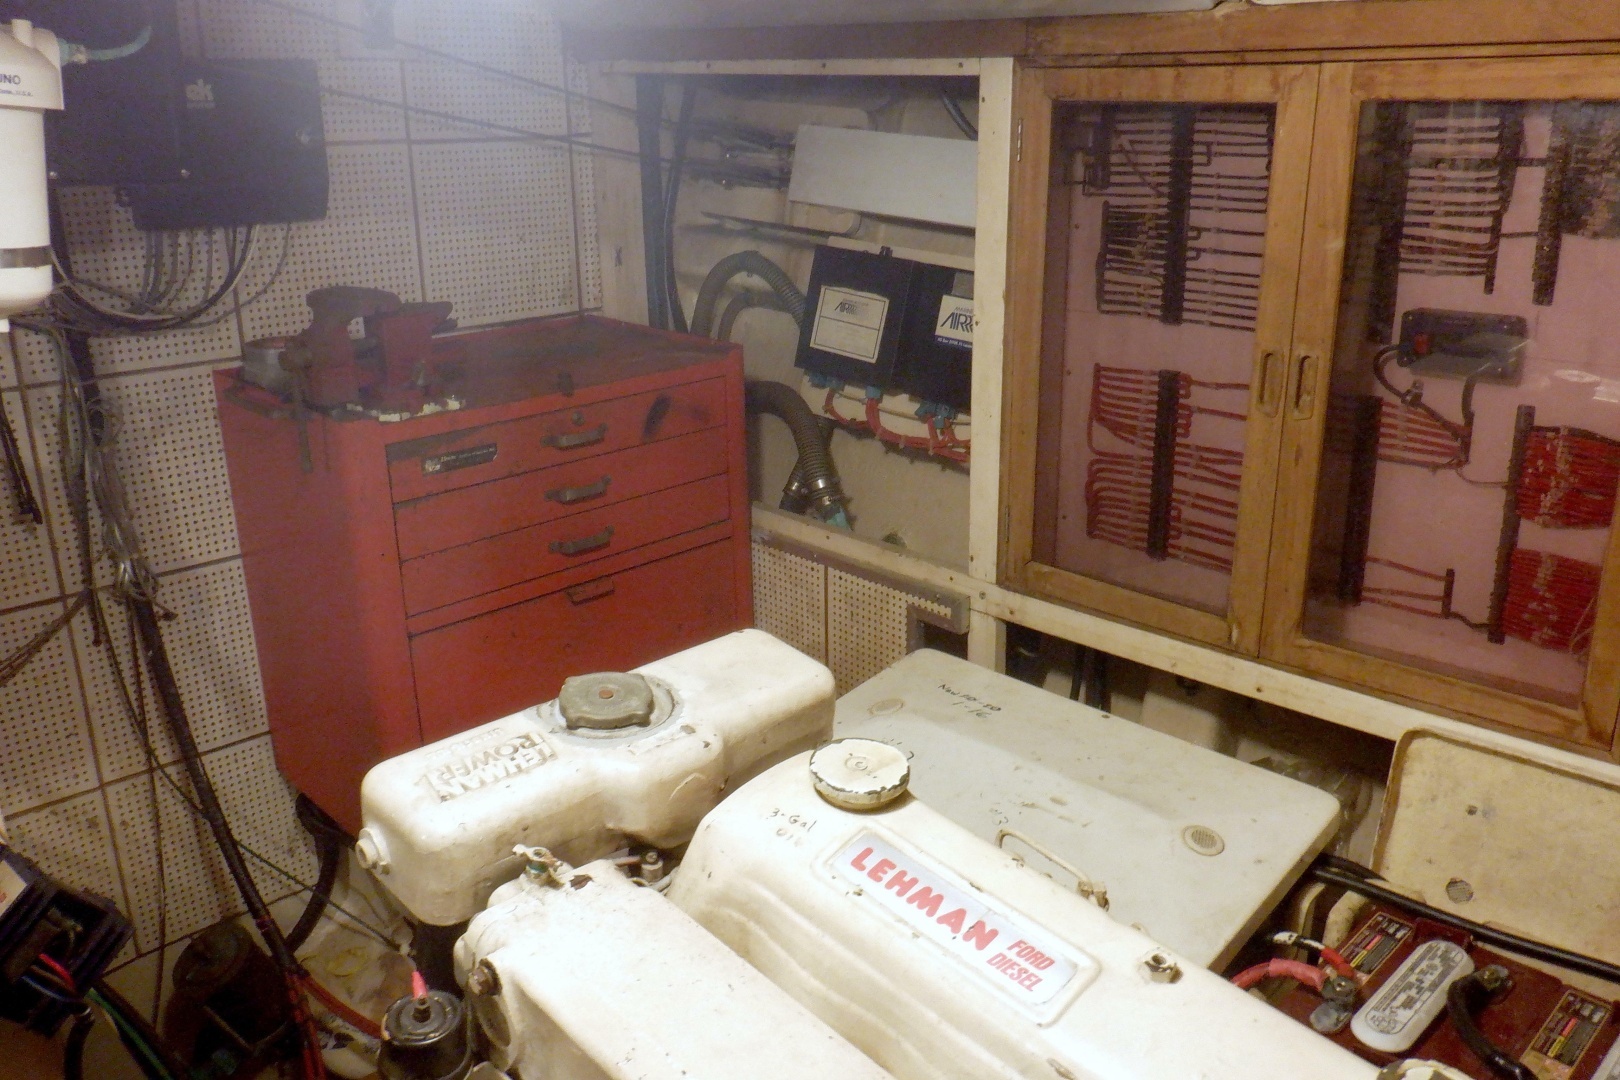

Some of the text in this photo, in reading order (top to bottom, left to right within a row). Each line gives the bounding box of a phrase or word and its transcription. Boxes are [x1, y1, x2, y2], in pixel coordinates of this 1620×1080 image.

[428, 731, 546, 785] POWER
[439, 738, 558, 803] LEHMAN
[850, 847, 999, 951] LEHMAN
[985, 952, 1043, 993] DIESEL
[1006, 939, 1056, 972] FORD
